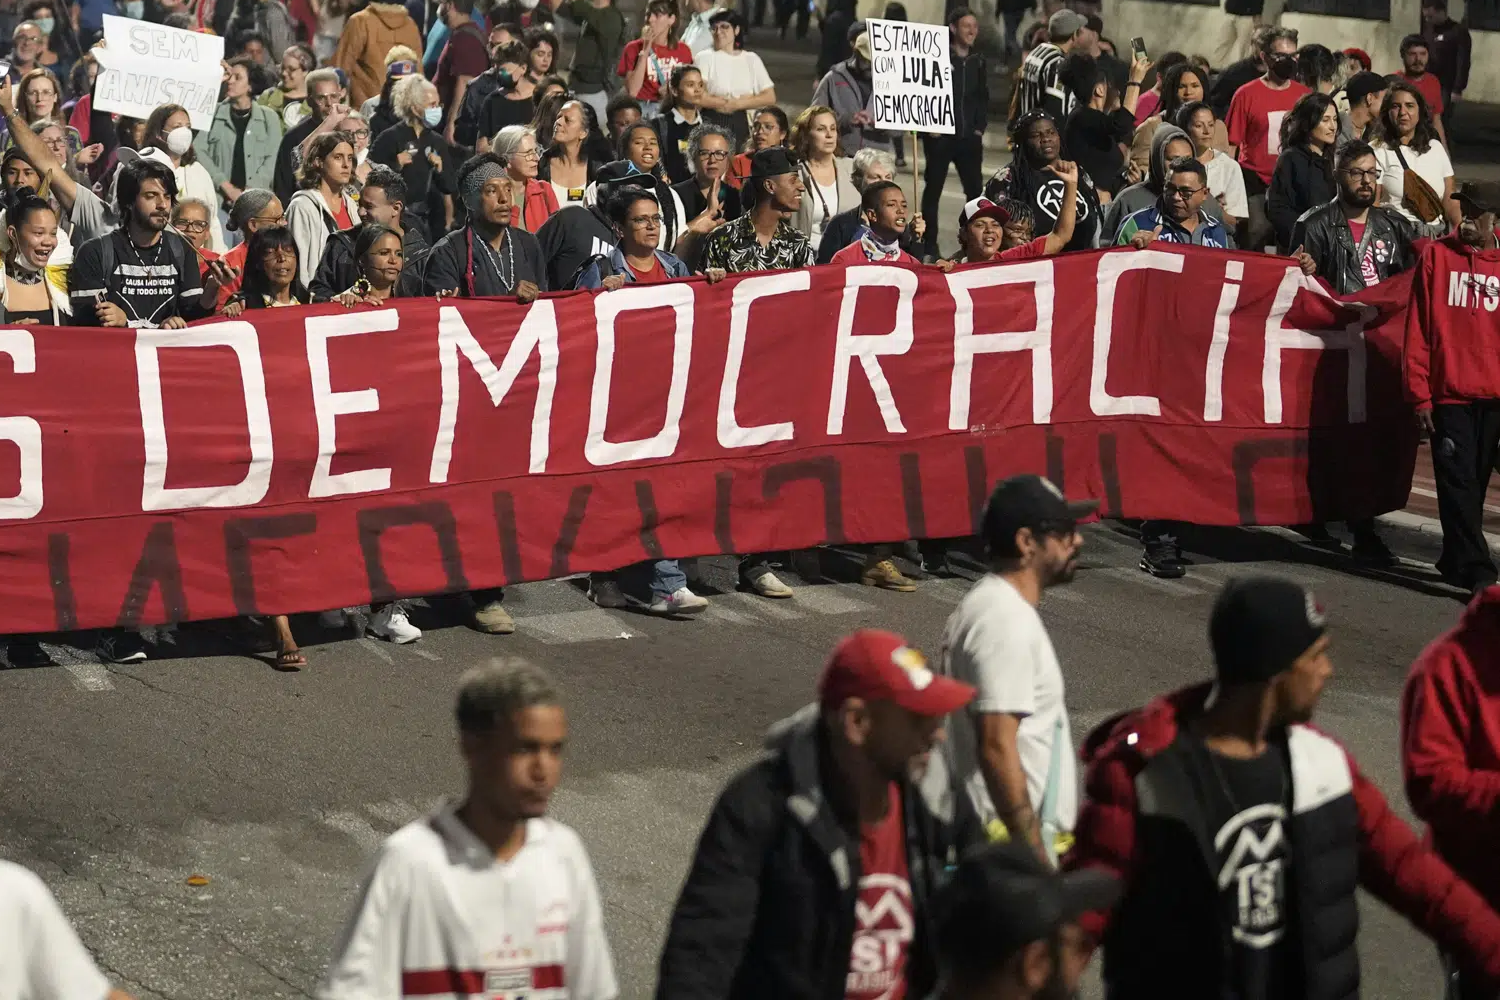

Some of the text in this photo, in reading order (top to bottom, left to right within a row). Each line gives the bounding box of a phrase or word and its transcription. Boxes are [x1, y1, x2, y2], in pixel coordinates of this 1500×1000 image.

[129, 25, 199, 62] SEM
[872, 23, 941, 58] ESTAMOS
[874, 56, 896, 73] COM
[902, 56, 943, 89] LULA
[100, 68, 216, 116] ANISTIA
[874, 94, 954, 126] DEMOCRACIA
[125, 278, 144, 287] CAUSA
[128, 287, 135, 295] DE
[137, 287, 158, 295] TODOS
[159, 286, 173, 295] NÓS
